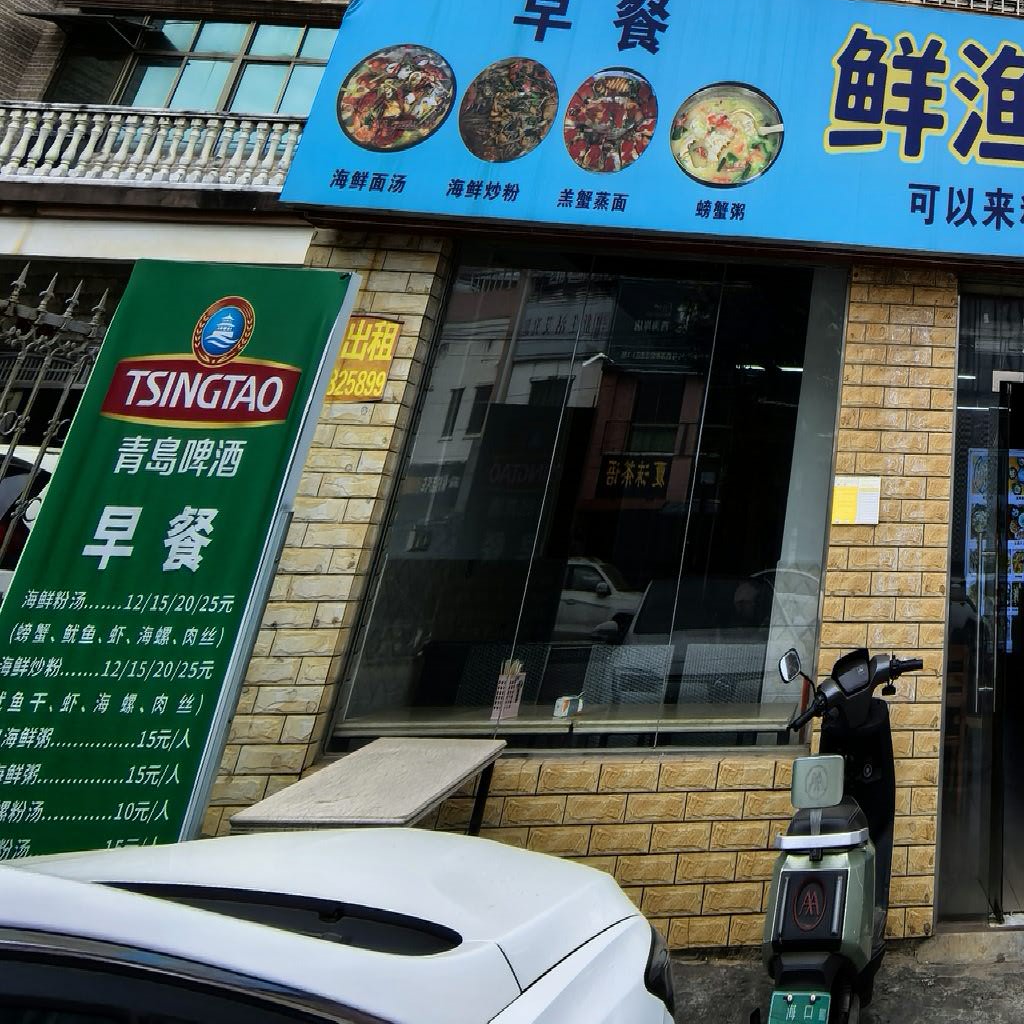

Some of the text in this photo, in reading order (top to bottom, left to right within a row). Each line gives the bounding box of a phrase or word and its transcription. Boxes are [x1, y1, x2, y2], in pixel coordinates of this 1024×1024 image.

[329, 169, 407, 193] 海鲜面汤
[446, 178, 520, 202] 海鲜炒粉
[695, 199, 746, 221] 螃蟹粥
[339, 319, 400, 361] 出租
[124, 369, 284, 413] TSINGTAO
[113, 435, 248, 478] 青島啤酒
[81, 504, 219, 572] 早餐
[21, 589, 235, 614] 海鲜粉汤 12/15/20/25元
[100, 659, 215, 680] 12/15/20/25元
[0, 727, 191, 750] 海鲜粥 15元/人
[125, 764, 181, 787] 15元/人
[113, 799, 170, 823] 10元/人
